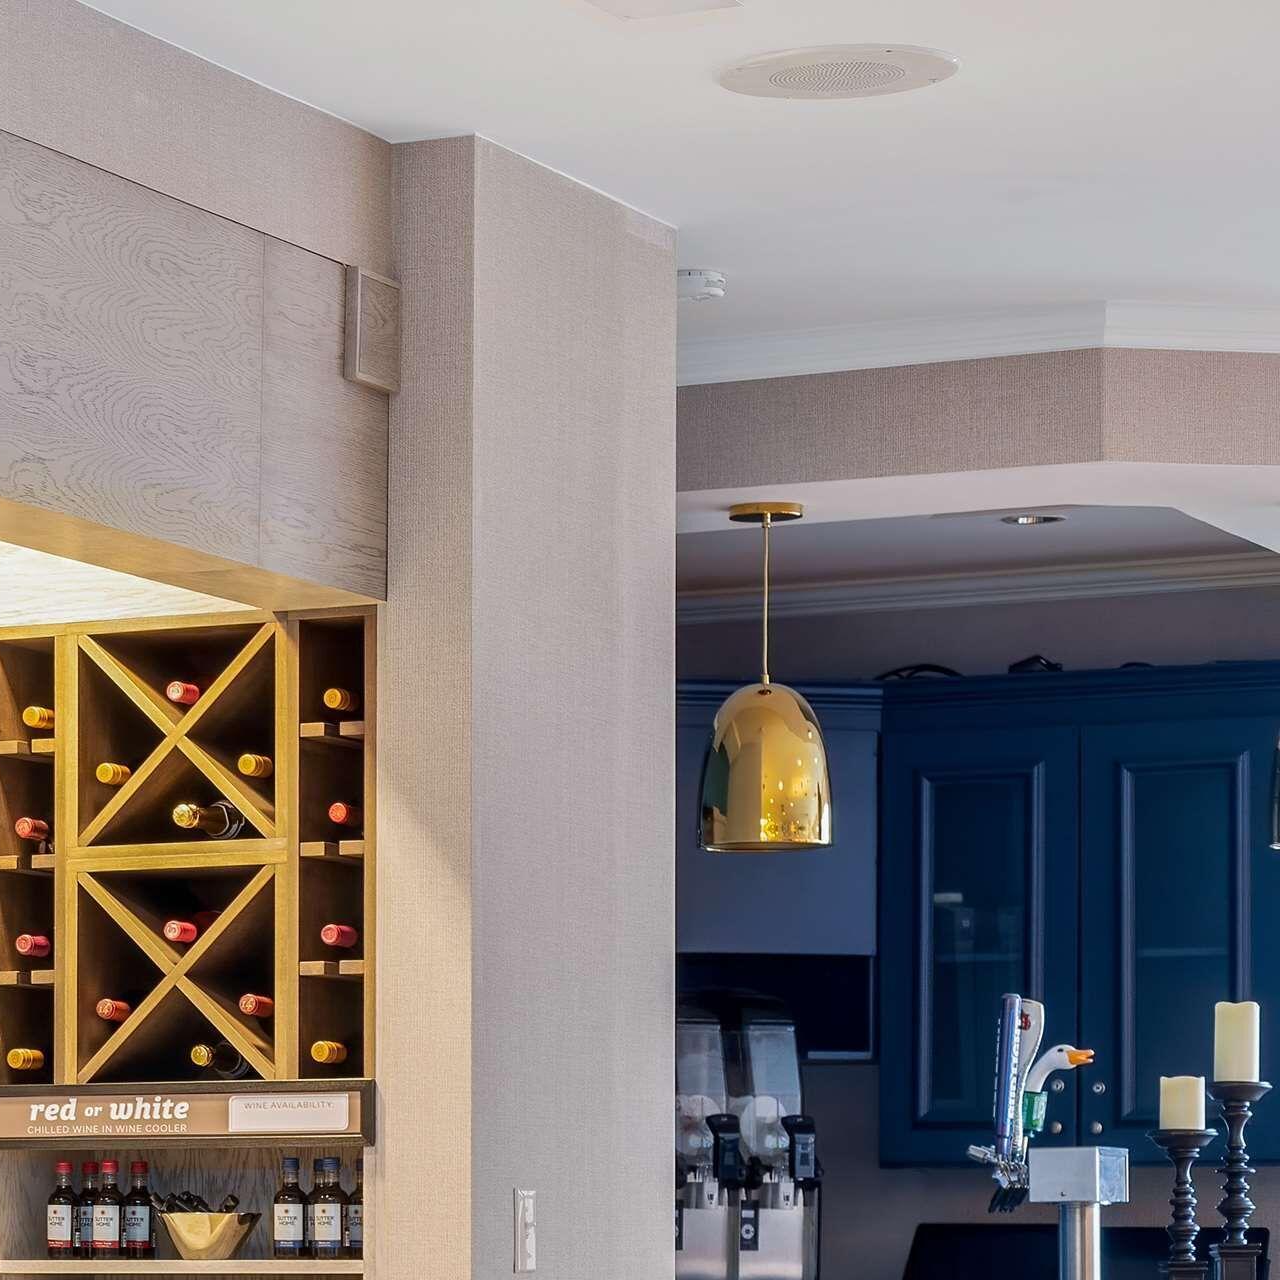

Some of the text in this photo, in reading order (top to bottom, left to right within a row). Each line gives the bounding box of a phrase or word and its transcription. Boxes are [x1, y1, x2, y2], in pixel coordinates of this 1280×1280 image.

[29, 1096, 190, 1121] red or white
[244, 1102, 269, 1110] WINE
[27, 1124, 188, 1134] CHILLED WINE IN WINE COOLER
